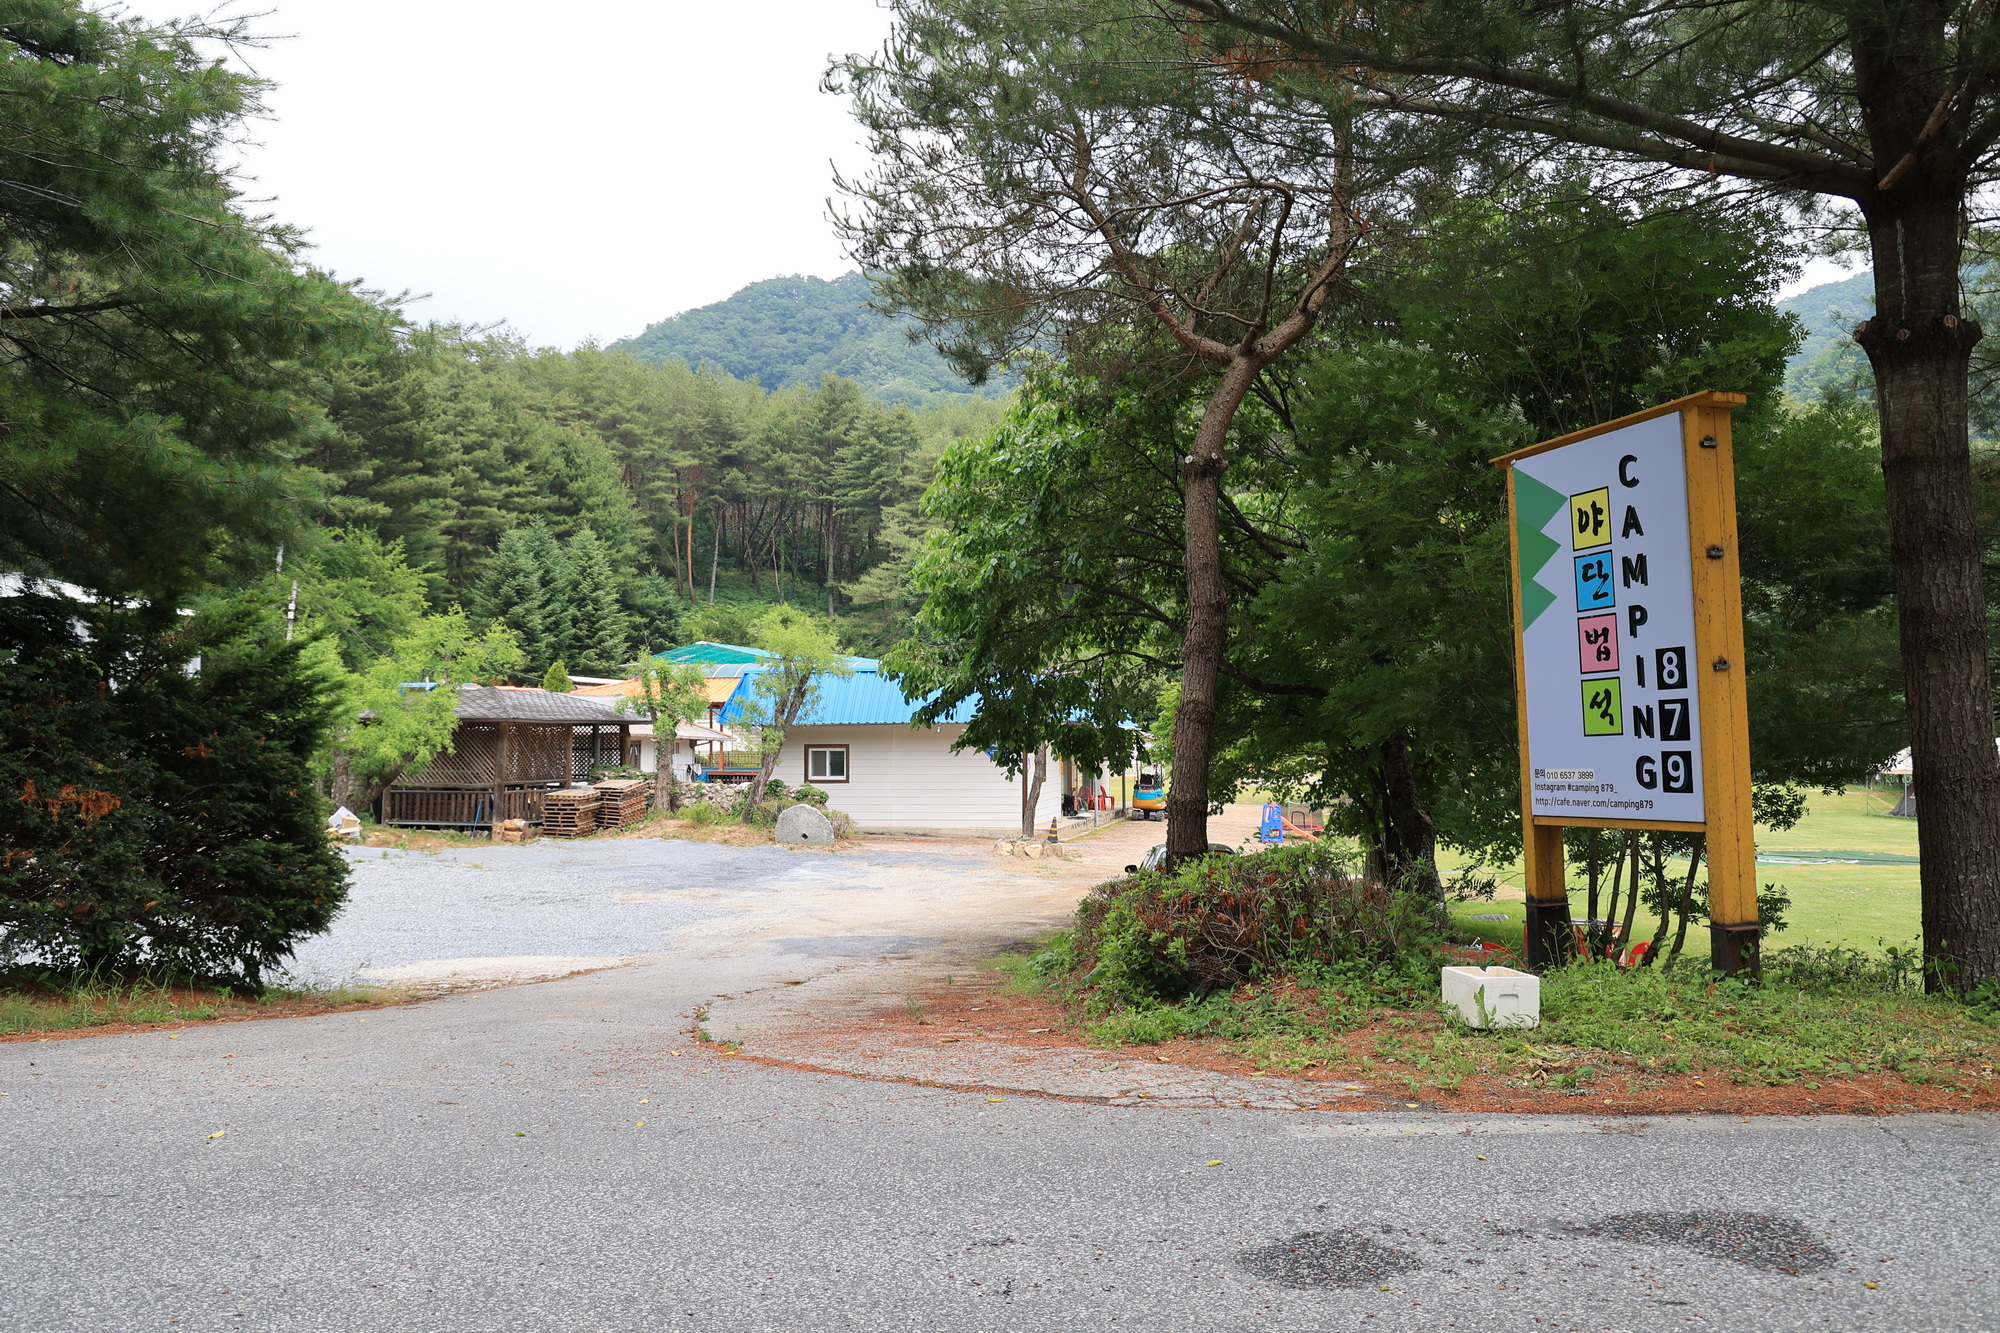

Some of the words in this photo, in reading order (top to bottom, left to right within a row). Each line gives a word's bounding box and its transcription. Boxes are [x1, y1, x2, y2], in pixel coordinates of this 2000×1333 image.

[1577, 500, 1614, 726] 야단법석
[1618, 454, 1658, 790] CAMPING
[1662, 651, 1686, 789] 879
[1534, 768, 1546, 779] 문의
[1546, 771, 1558, 780] 010
[1559, 771, 1576, 780] 6537
[1577, 771, 1594, 780] 3899
[1534, 783, 1566, 794] Instagram
[1567, 783, 1600, 795] #camping
[1535, 797, 1654, 810] http://cafe.naver.com/camping879
